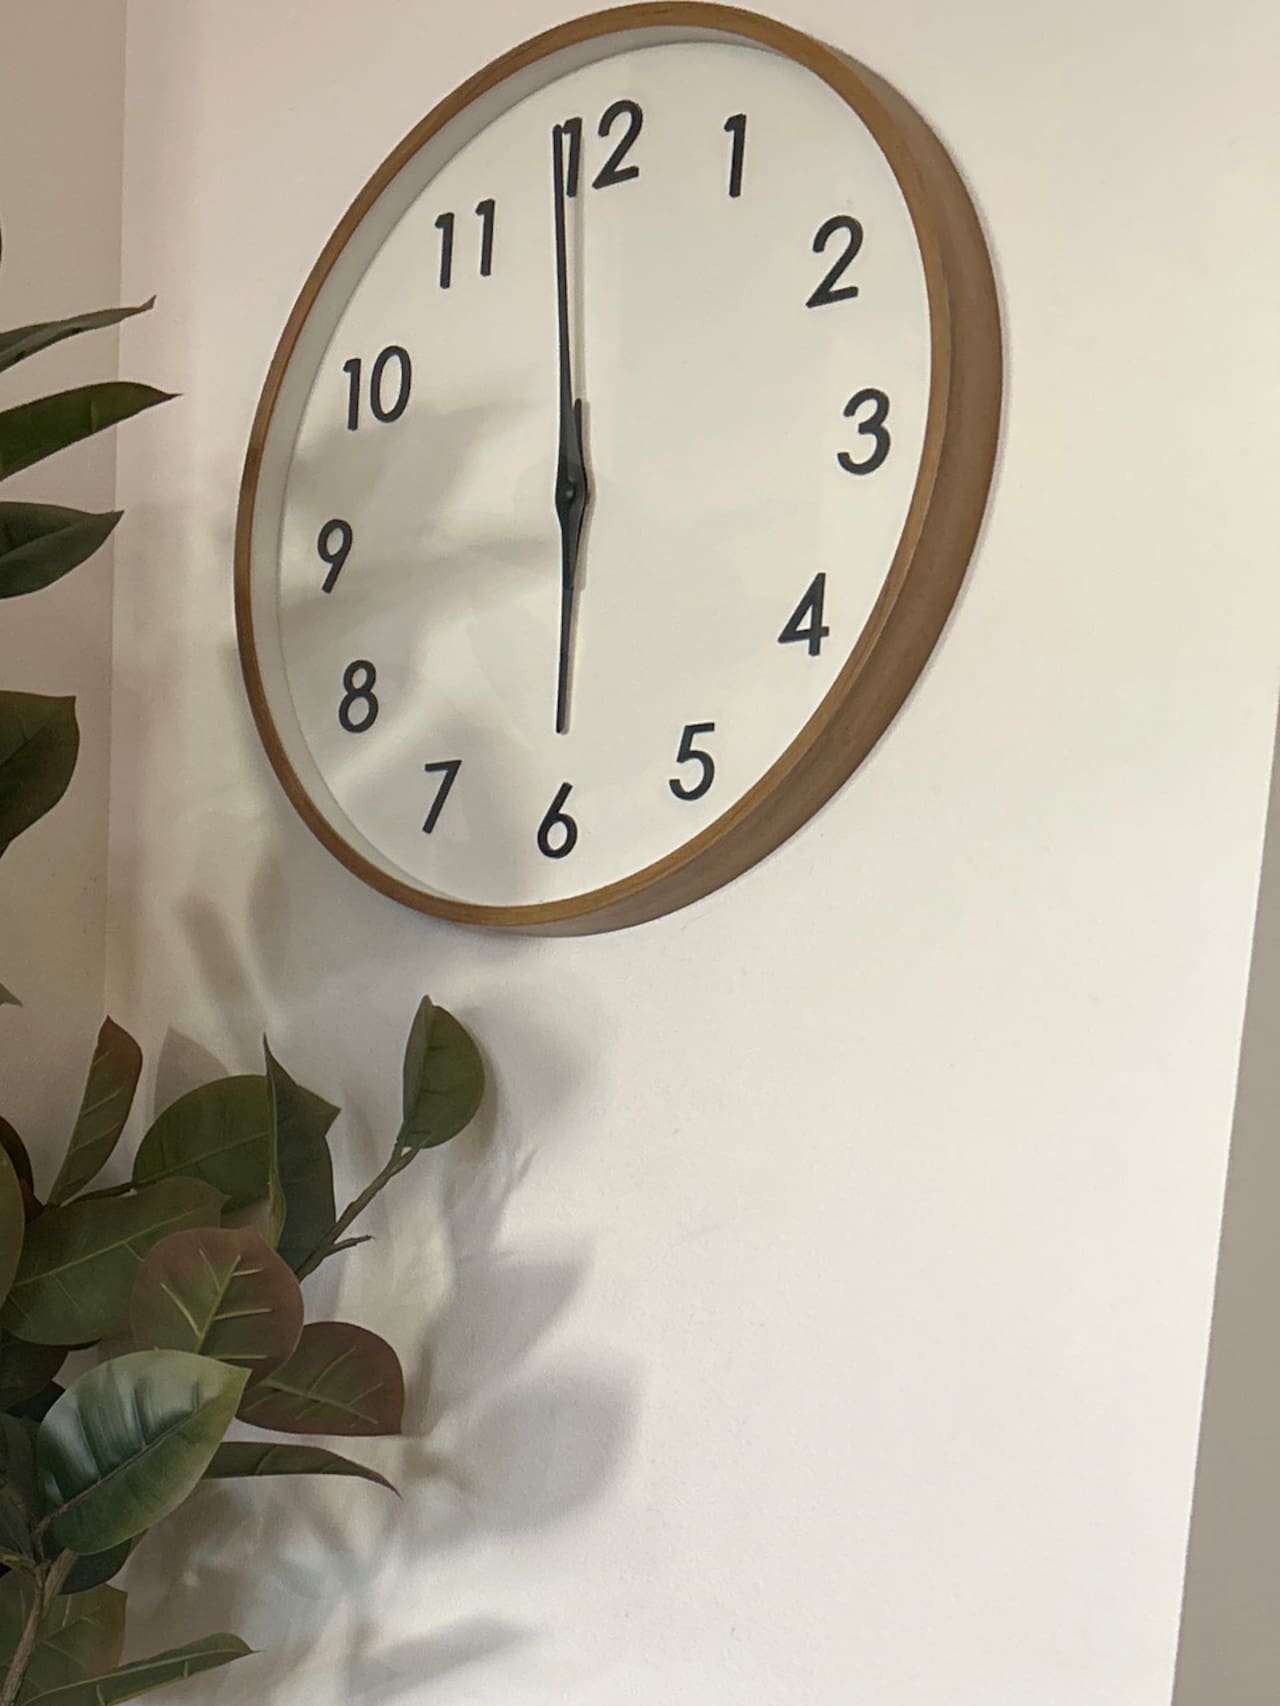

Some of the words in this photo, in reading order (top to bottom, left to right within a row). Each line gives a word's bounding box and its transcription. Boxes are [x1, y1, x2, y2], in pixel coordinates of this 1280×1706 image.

[561, 99, 645, 198] 12
[723, 112, 749, 199] 1
[433, 198, 498, 289] 11
[804, 214, 865, 309] 2
[342, 344, 413, 432] 10
[835, 387, 892, 476] 3
[316, 517, 355, 594] 9
[777, 571, 830, 657] 4
[337, 658, 380, 735] 8
[422, 759, 463, 835] 7
[668, 721, 717, 802] 5
[536, 781, 579, 860] 6
